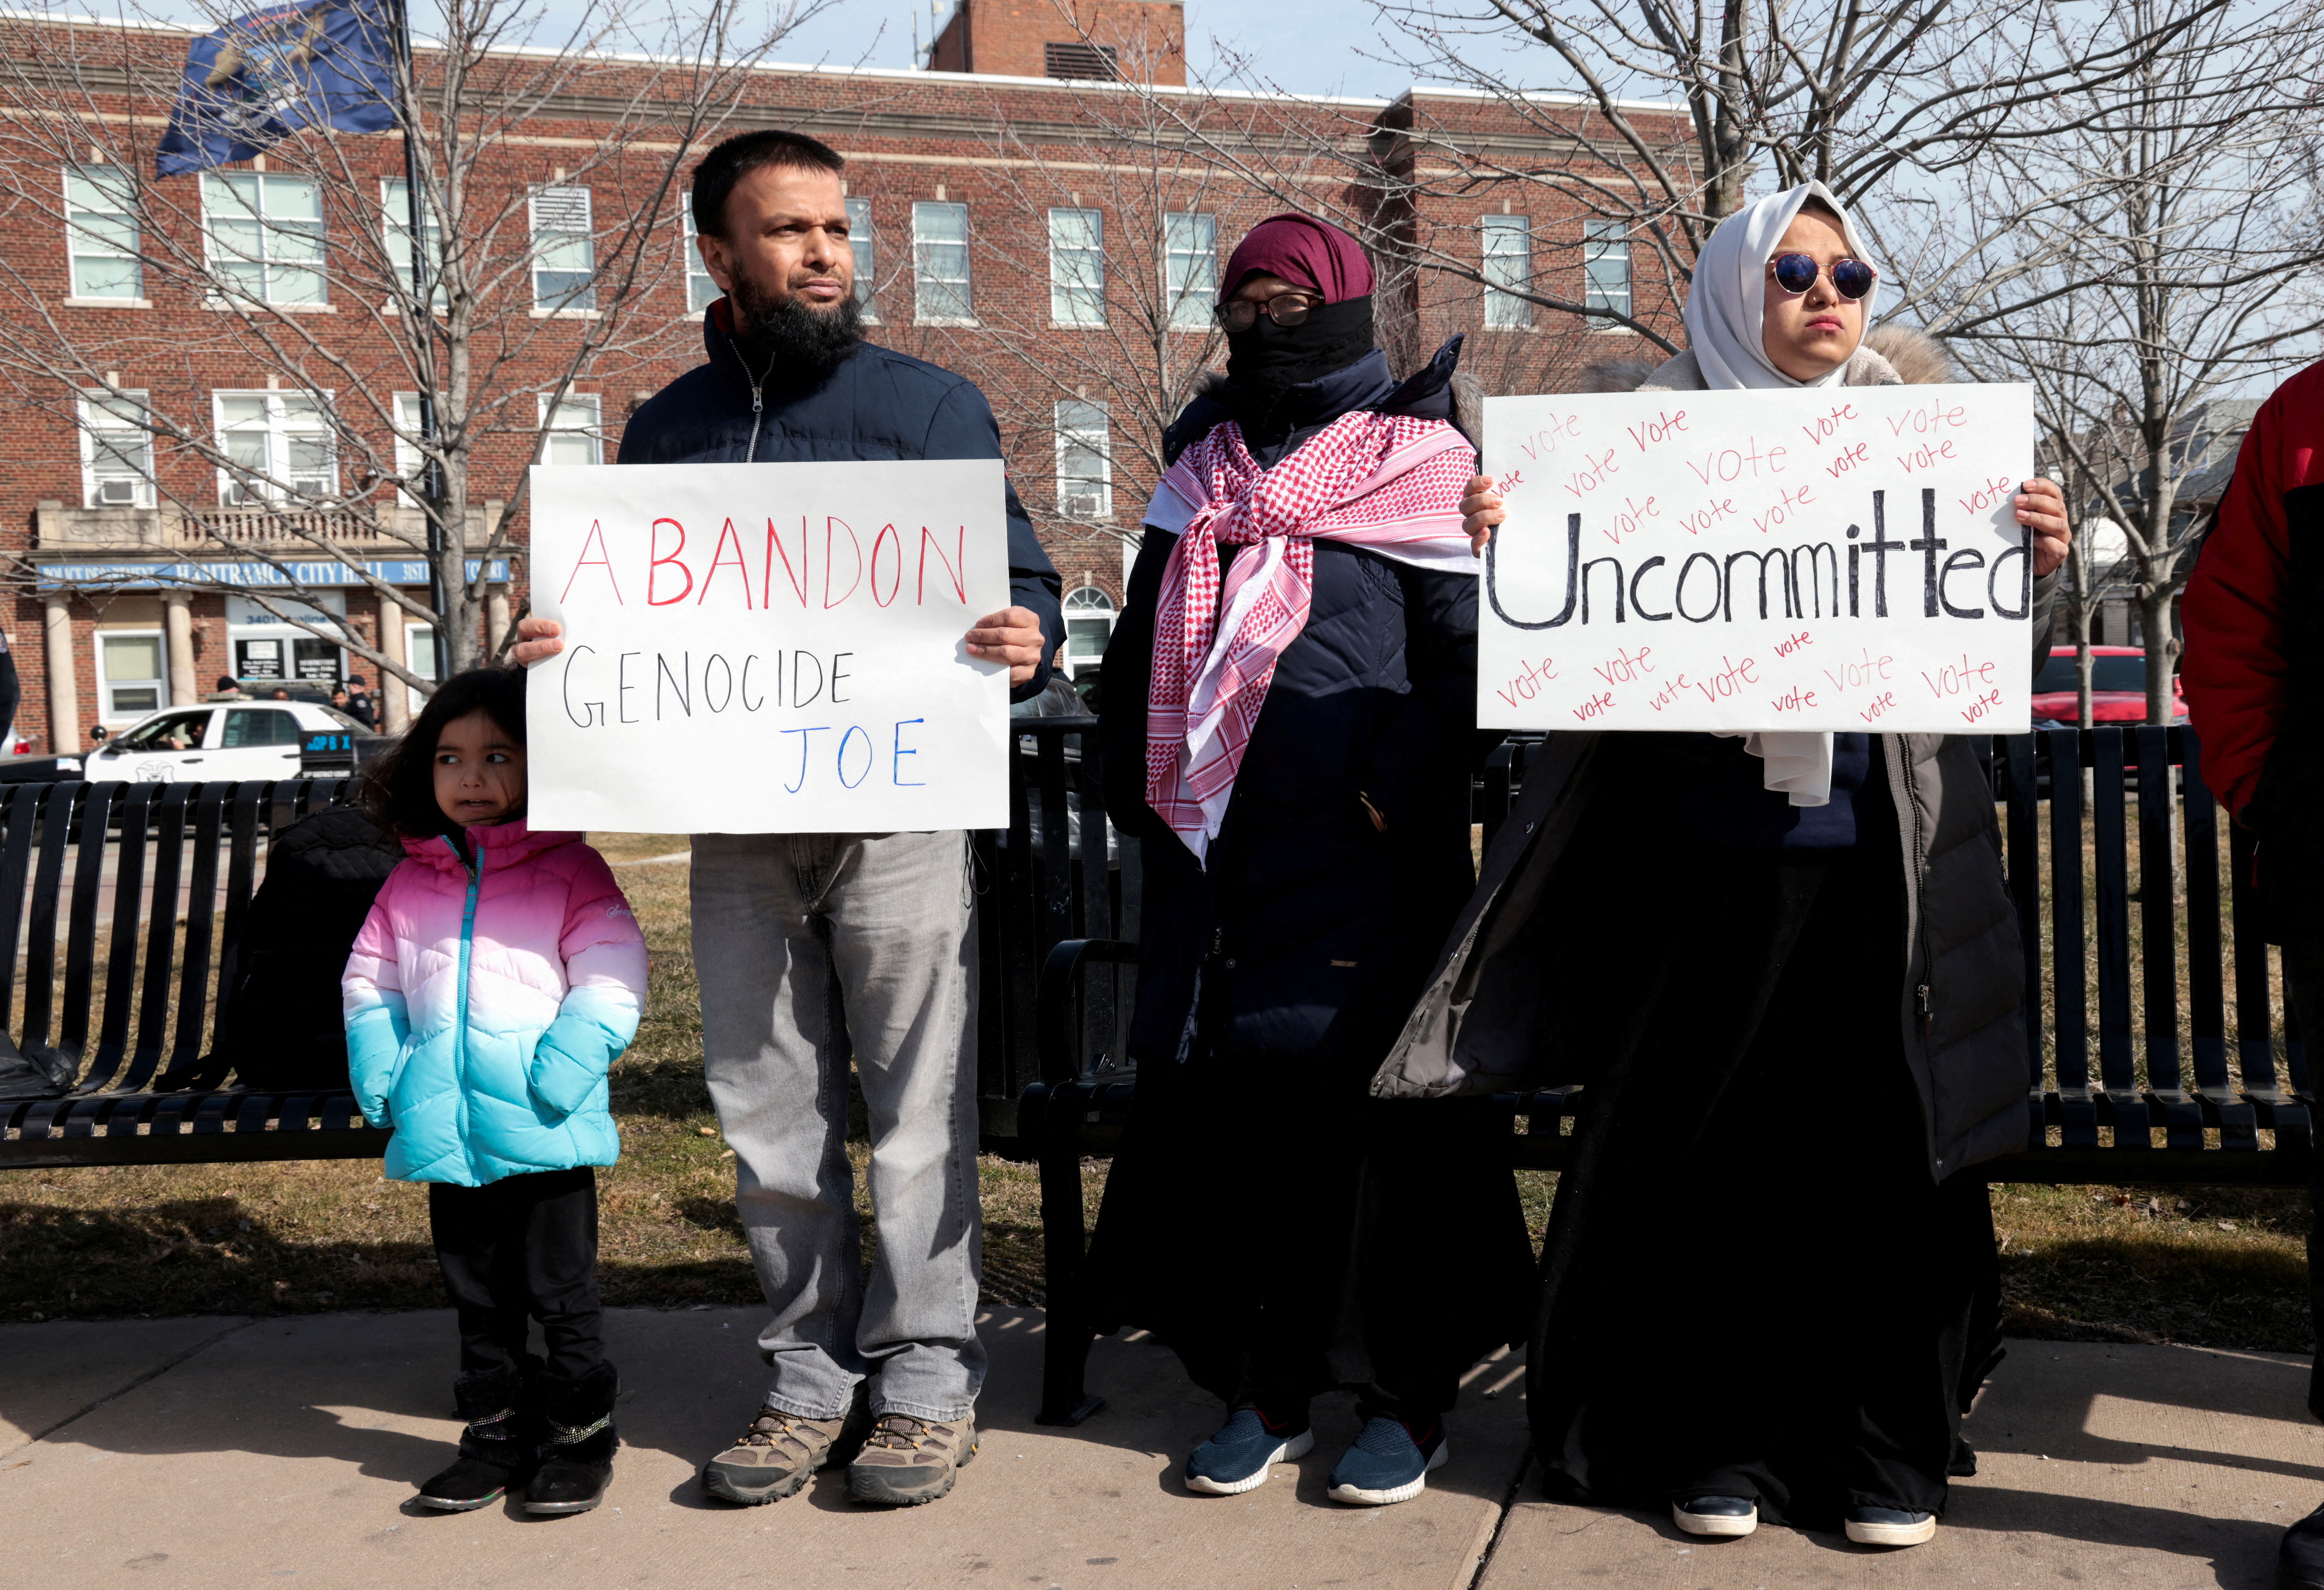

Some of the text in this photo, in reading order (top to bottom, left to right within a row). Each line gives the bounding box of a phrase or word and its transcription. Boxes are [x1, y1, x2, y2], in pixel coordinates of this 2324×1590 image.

[296, 562, 338, 584] CITY
[342, 562, 388, 583] HLL
[470, 562, 503, 580] CRT
[560, 516, 966, 610] ABANDON
[1485, 481, 2032, 630] Uncommitted
[563, 645, 853, 728] GENOCIDE
[779, 718, 926, 794] JOE
